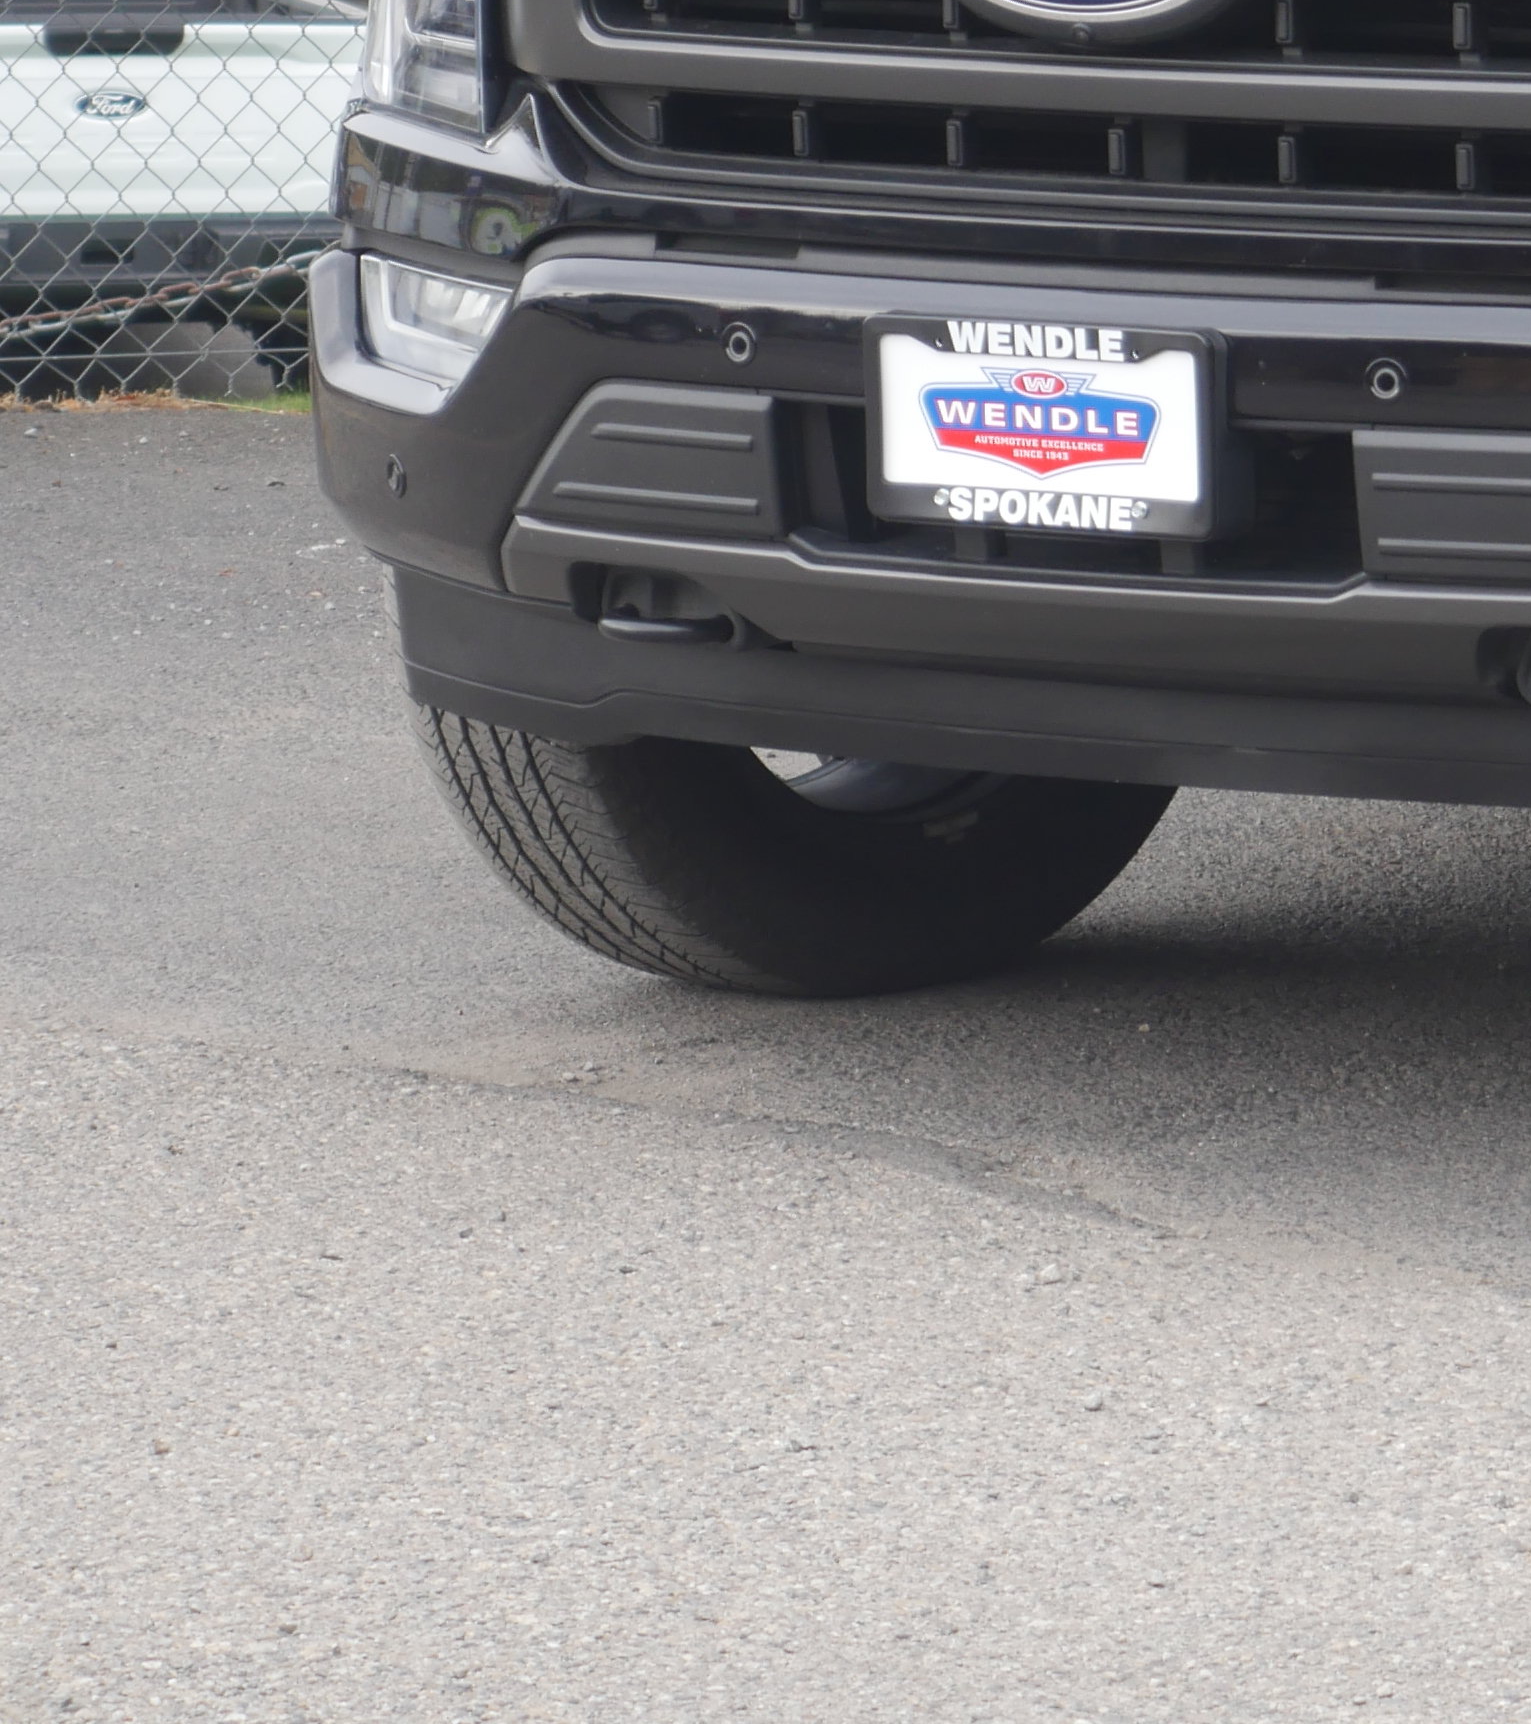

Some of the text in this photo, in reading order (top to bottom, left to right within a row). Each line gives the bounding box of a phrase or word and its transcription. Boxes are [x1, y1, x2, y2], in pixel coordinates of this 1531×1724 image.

[86, 94, 136, 115] Ford
[947, 320, 1125, 362] WENDLE
[936, 399, 1139, 437] WENDLE
[974, 434, 1104, 453] AUTOMOTIVE EXCELLENCE
[1012, 448, 1043, 459] SINCE
[949, 486, 1133, 530] SPOKANE
